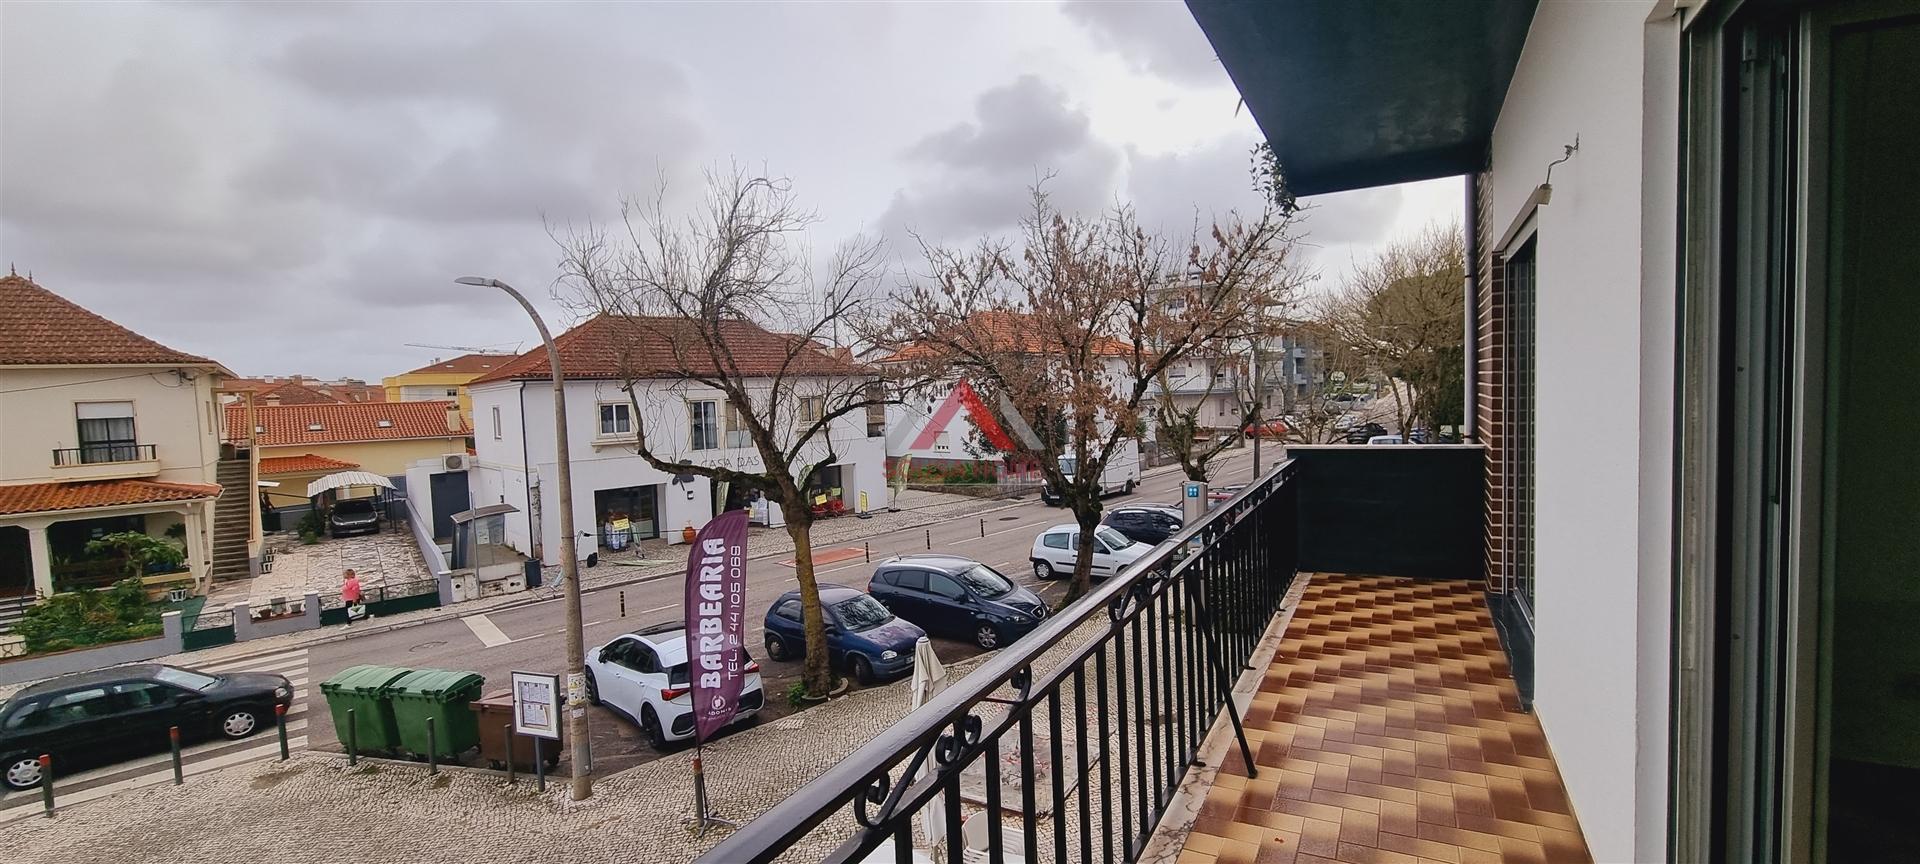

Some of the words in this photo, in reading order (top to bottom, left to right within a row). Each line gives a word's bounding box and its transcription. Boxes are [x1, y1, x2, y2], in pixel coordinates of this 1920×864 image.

[701, 458, 732, 468] CASA
[737, 456, 760, 468] DAS
[700, 538, 726, 688] BARBEARIA
[728, 648, 739, 681] TEL:
